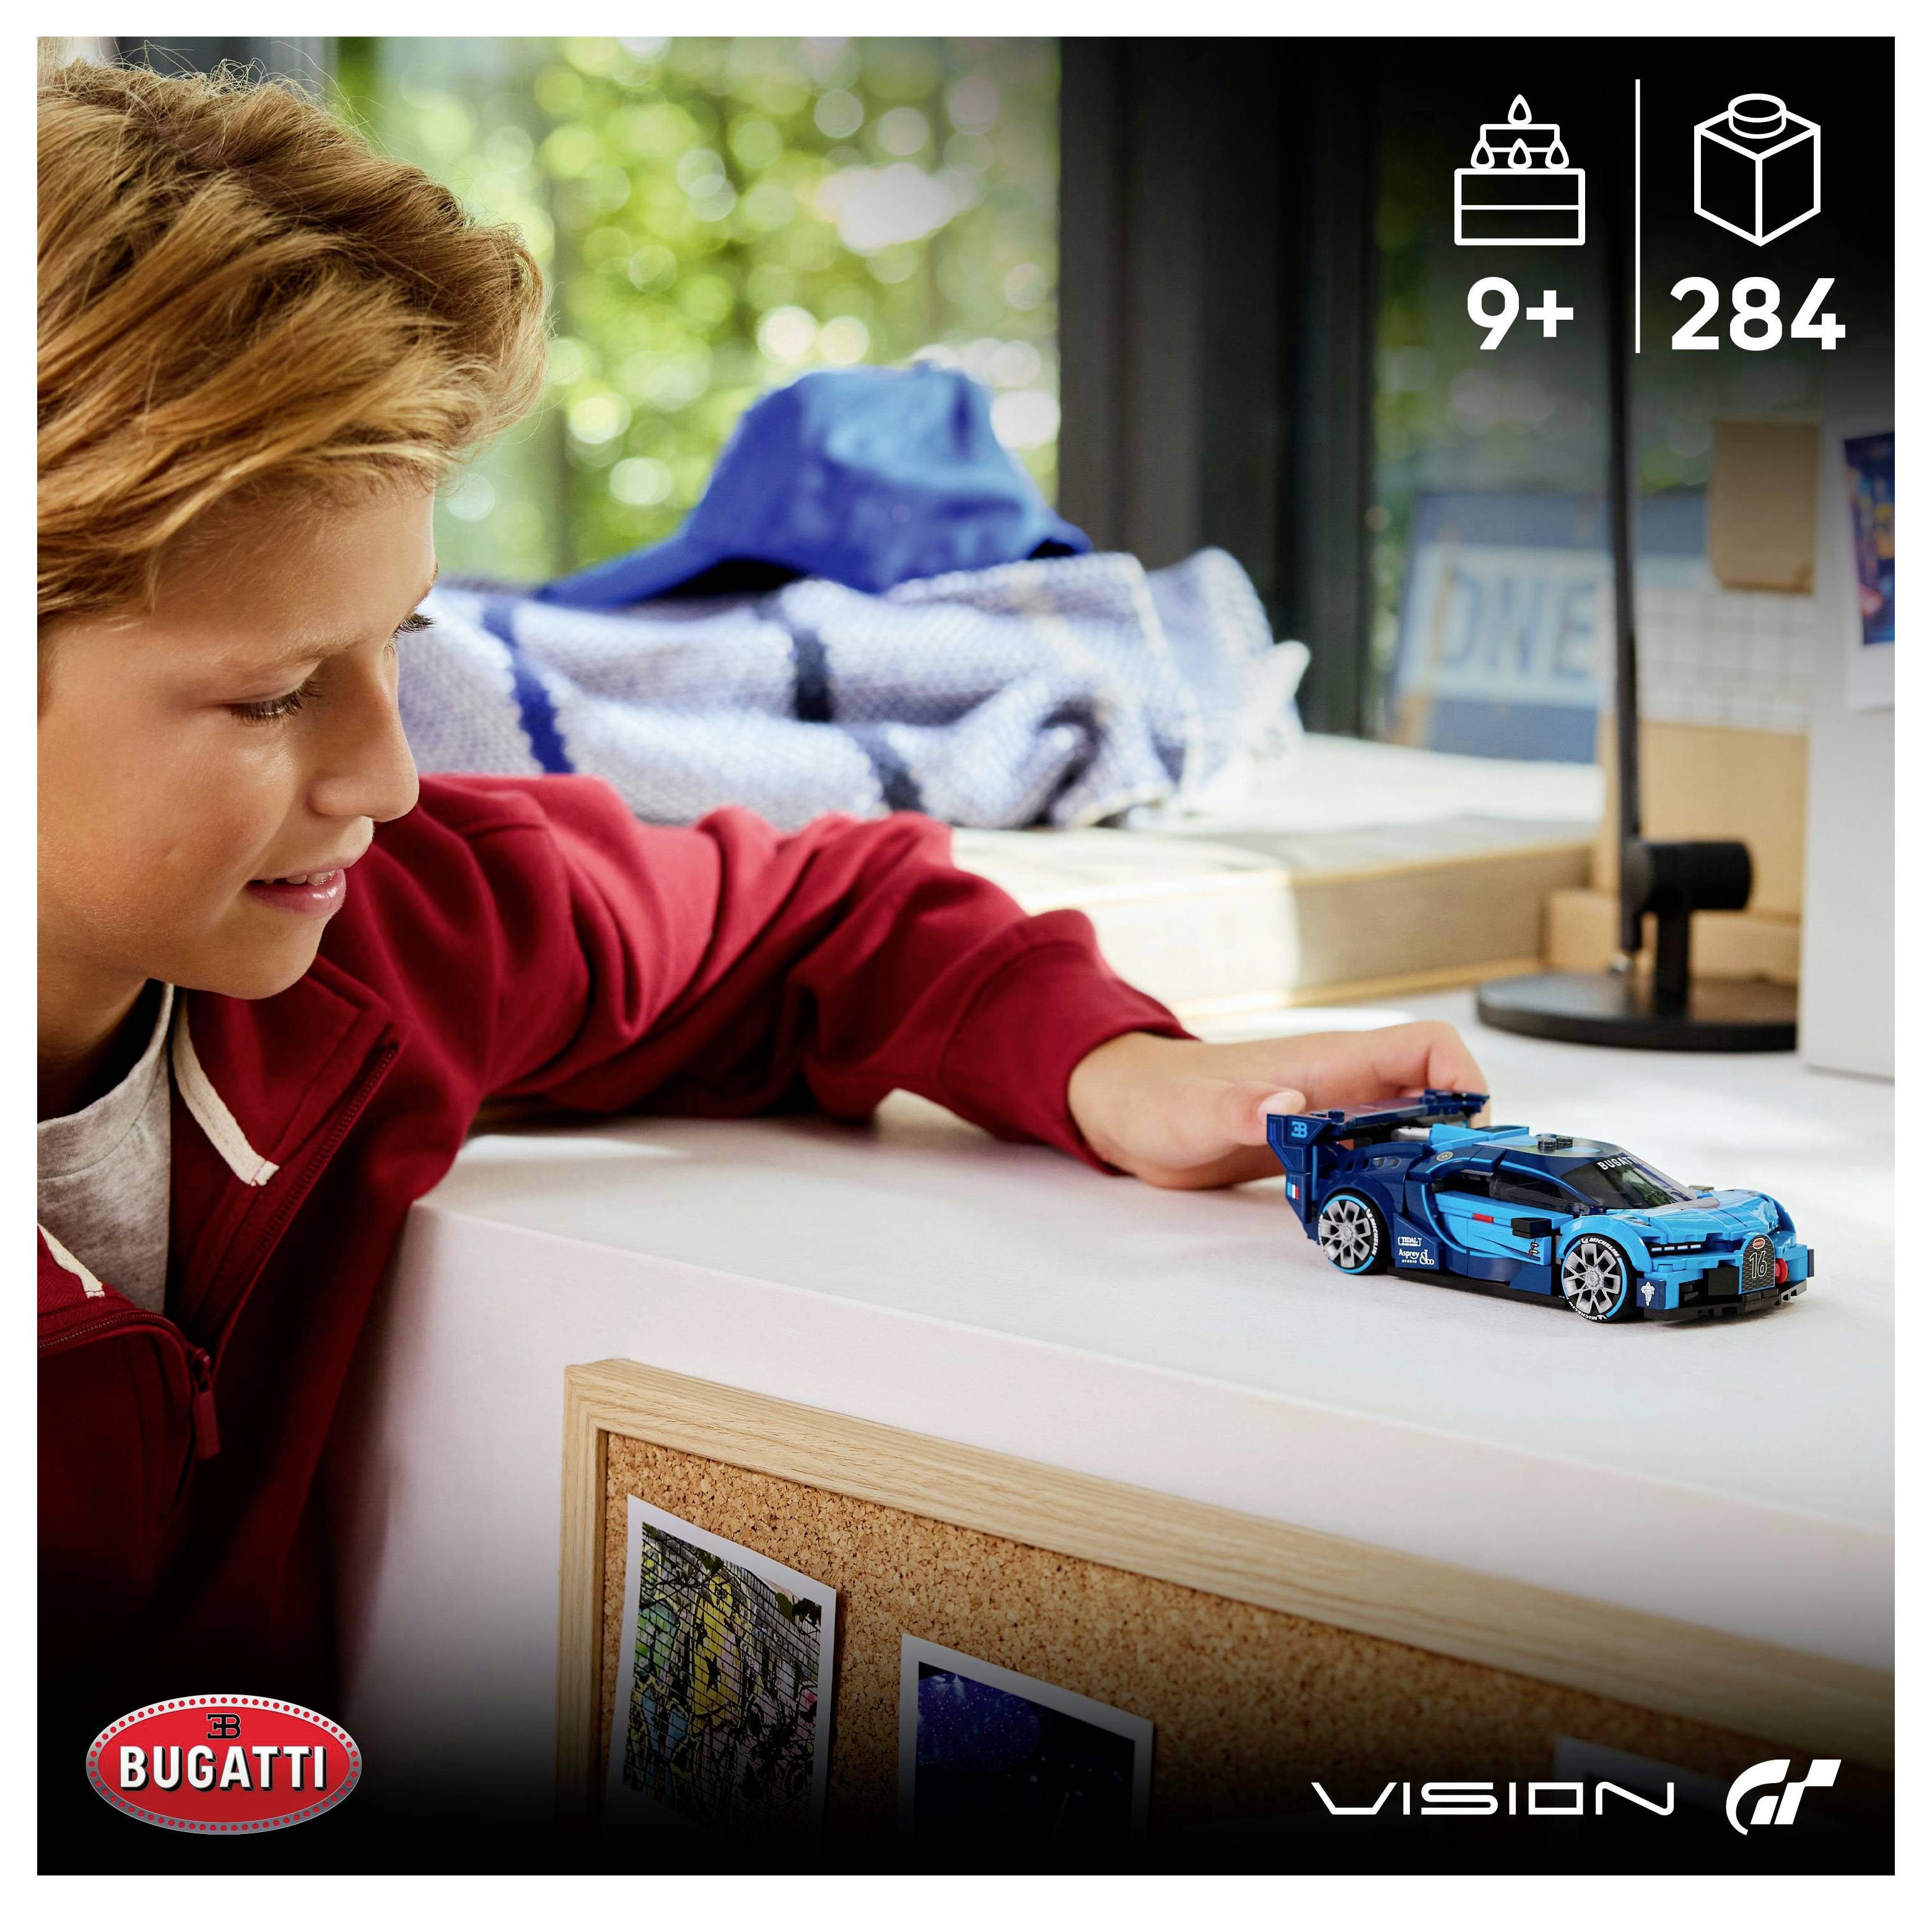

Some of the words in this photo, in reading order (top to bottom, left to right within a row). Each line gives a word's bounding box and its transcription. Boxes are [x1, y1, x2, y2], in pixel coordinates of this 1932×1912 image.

[1399, 1248, 1420, 1260] Asprey
[1589, 1237, 1620, 1257] MICHELIN
[1749, 1250, 1767, 1279] 16
